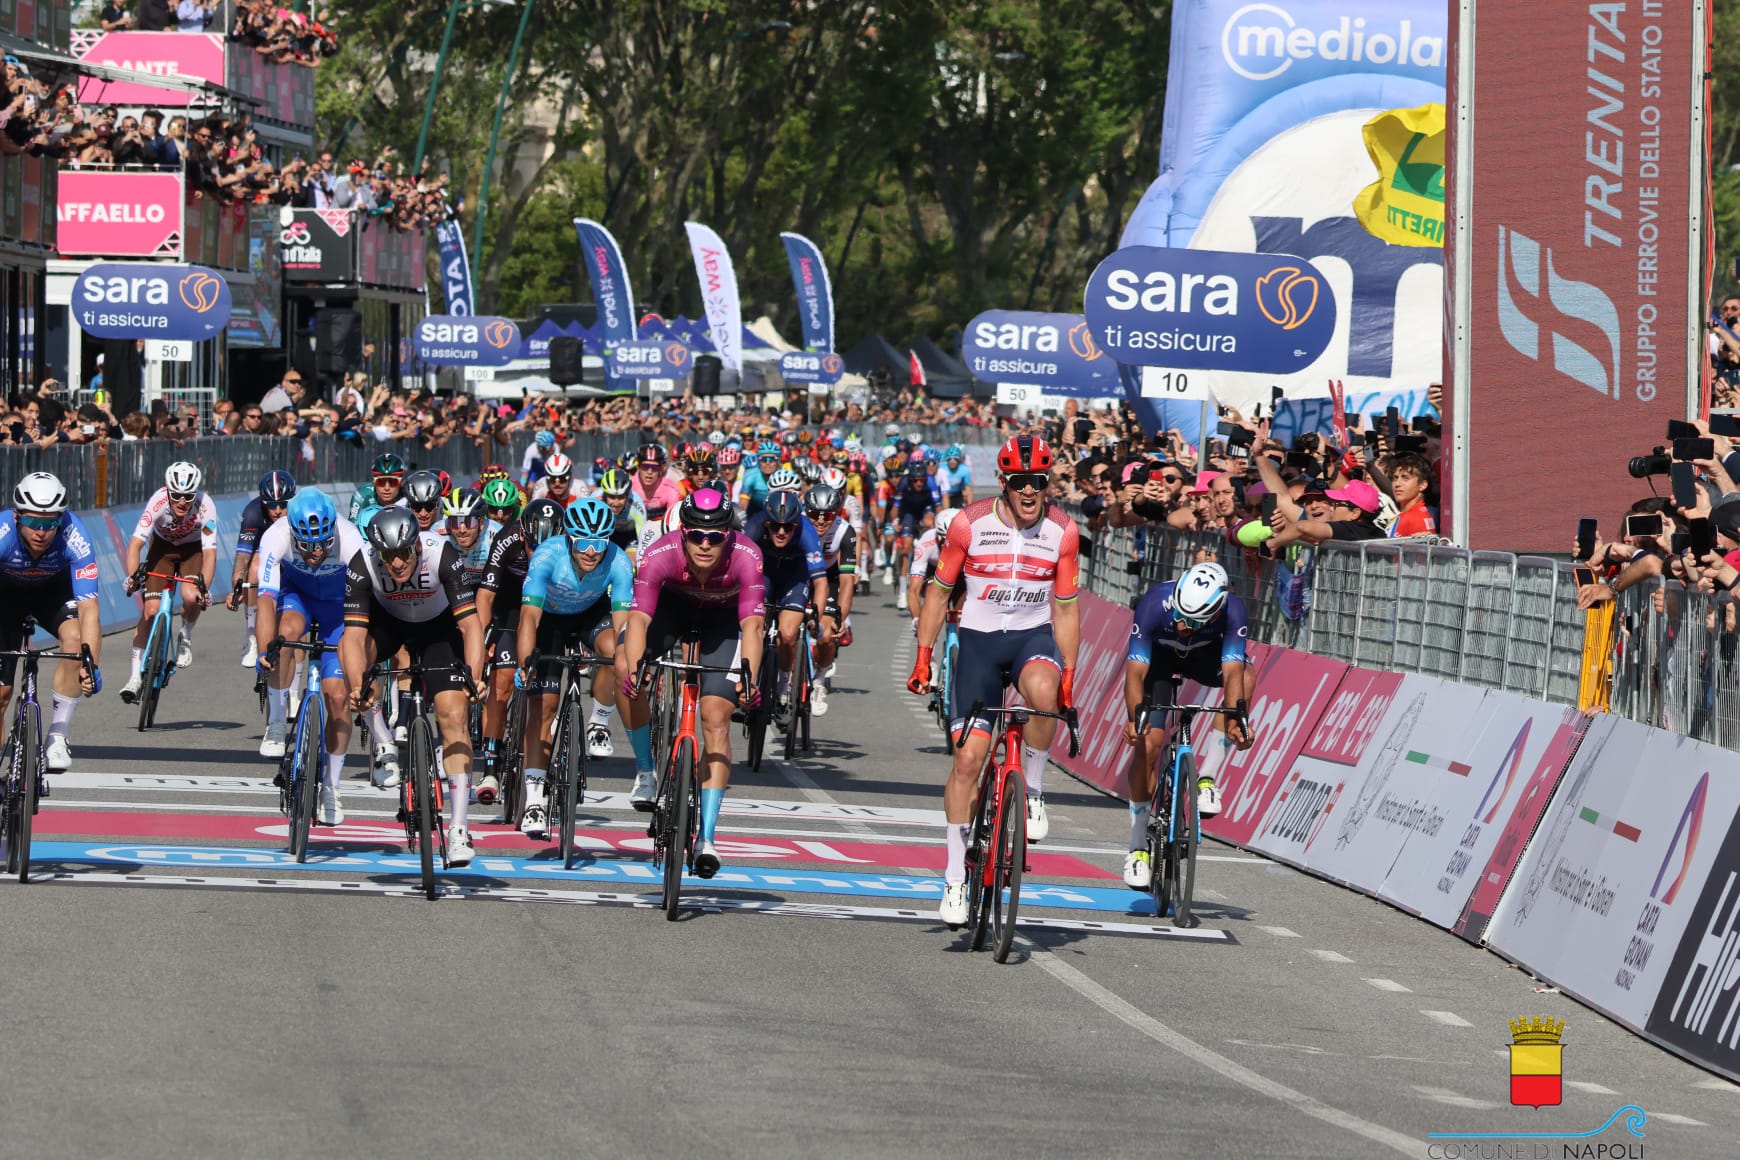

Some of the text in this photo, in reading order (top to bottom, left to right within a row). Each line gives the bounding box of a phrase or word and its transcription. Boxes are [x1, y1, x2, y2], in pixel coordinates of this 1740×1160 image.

[1237, 15, 1443, 68] mediola
[1641, 25, 1662, 98] STATO
[1584, 2, 1626, 248] TRENITA
[1639, 105, 1661, 178] DELLO
[1637, 186, 1659, 296] FERROVIE
[700, 246, 721, 293] way
[83, 275, 169, 305] sara
[1105, 268, 1238, 316] sara
[83, 311, 168, 328] ti assicura
[421, 322, 478, 344] sara
[974, 320, 1059, 352] sara
[1104, 323, 1236, 353] ti assicura
[162, 345, 179, 358] 50
[421, 347, 478, 359] ti assicura
[616, 346, 662, 363] sara
[782, 355, 820, 370] sara
[974, 356, 1058, 375] ti assicura
[1636, 303, 1658, 402] GRUPPO
[471, 369, 488, 379] 100
[1162, 372, 1188, 393] 10
[1009, 388, 1026, 400] 50
[490, 533, 520, 567] youfone
[381, 572, 432, 594] UAE
[972, 561, 1054, 577] TREK
[977, 584, 1046, 603] Segafredo
[1311, 676, 1375, 753] enel
[1271, 778, 1333, 843] TUDOR
[1636, 901, 1662, 937] CARTA
